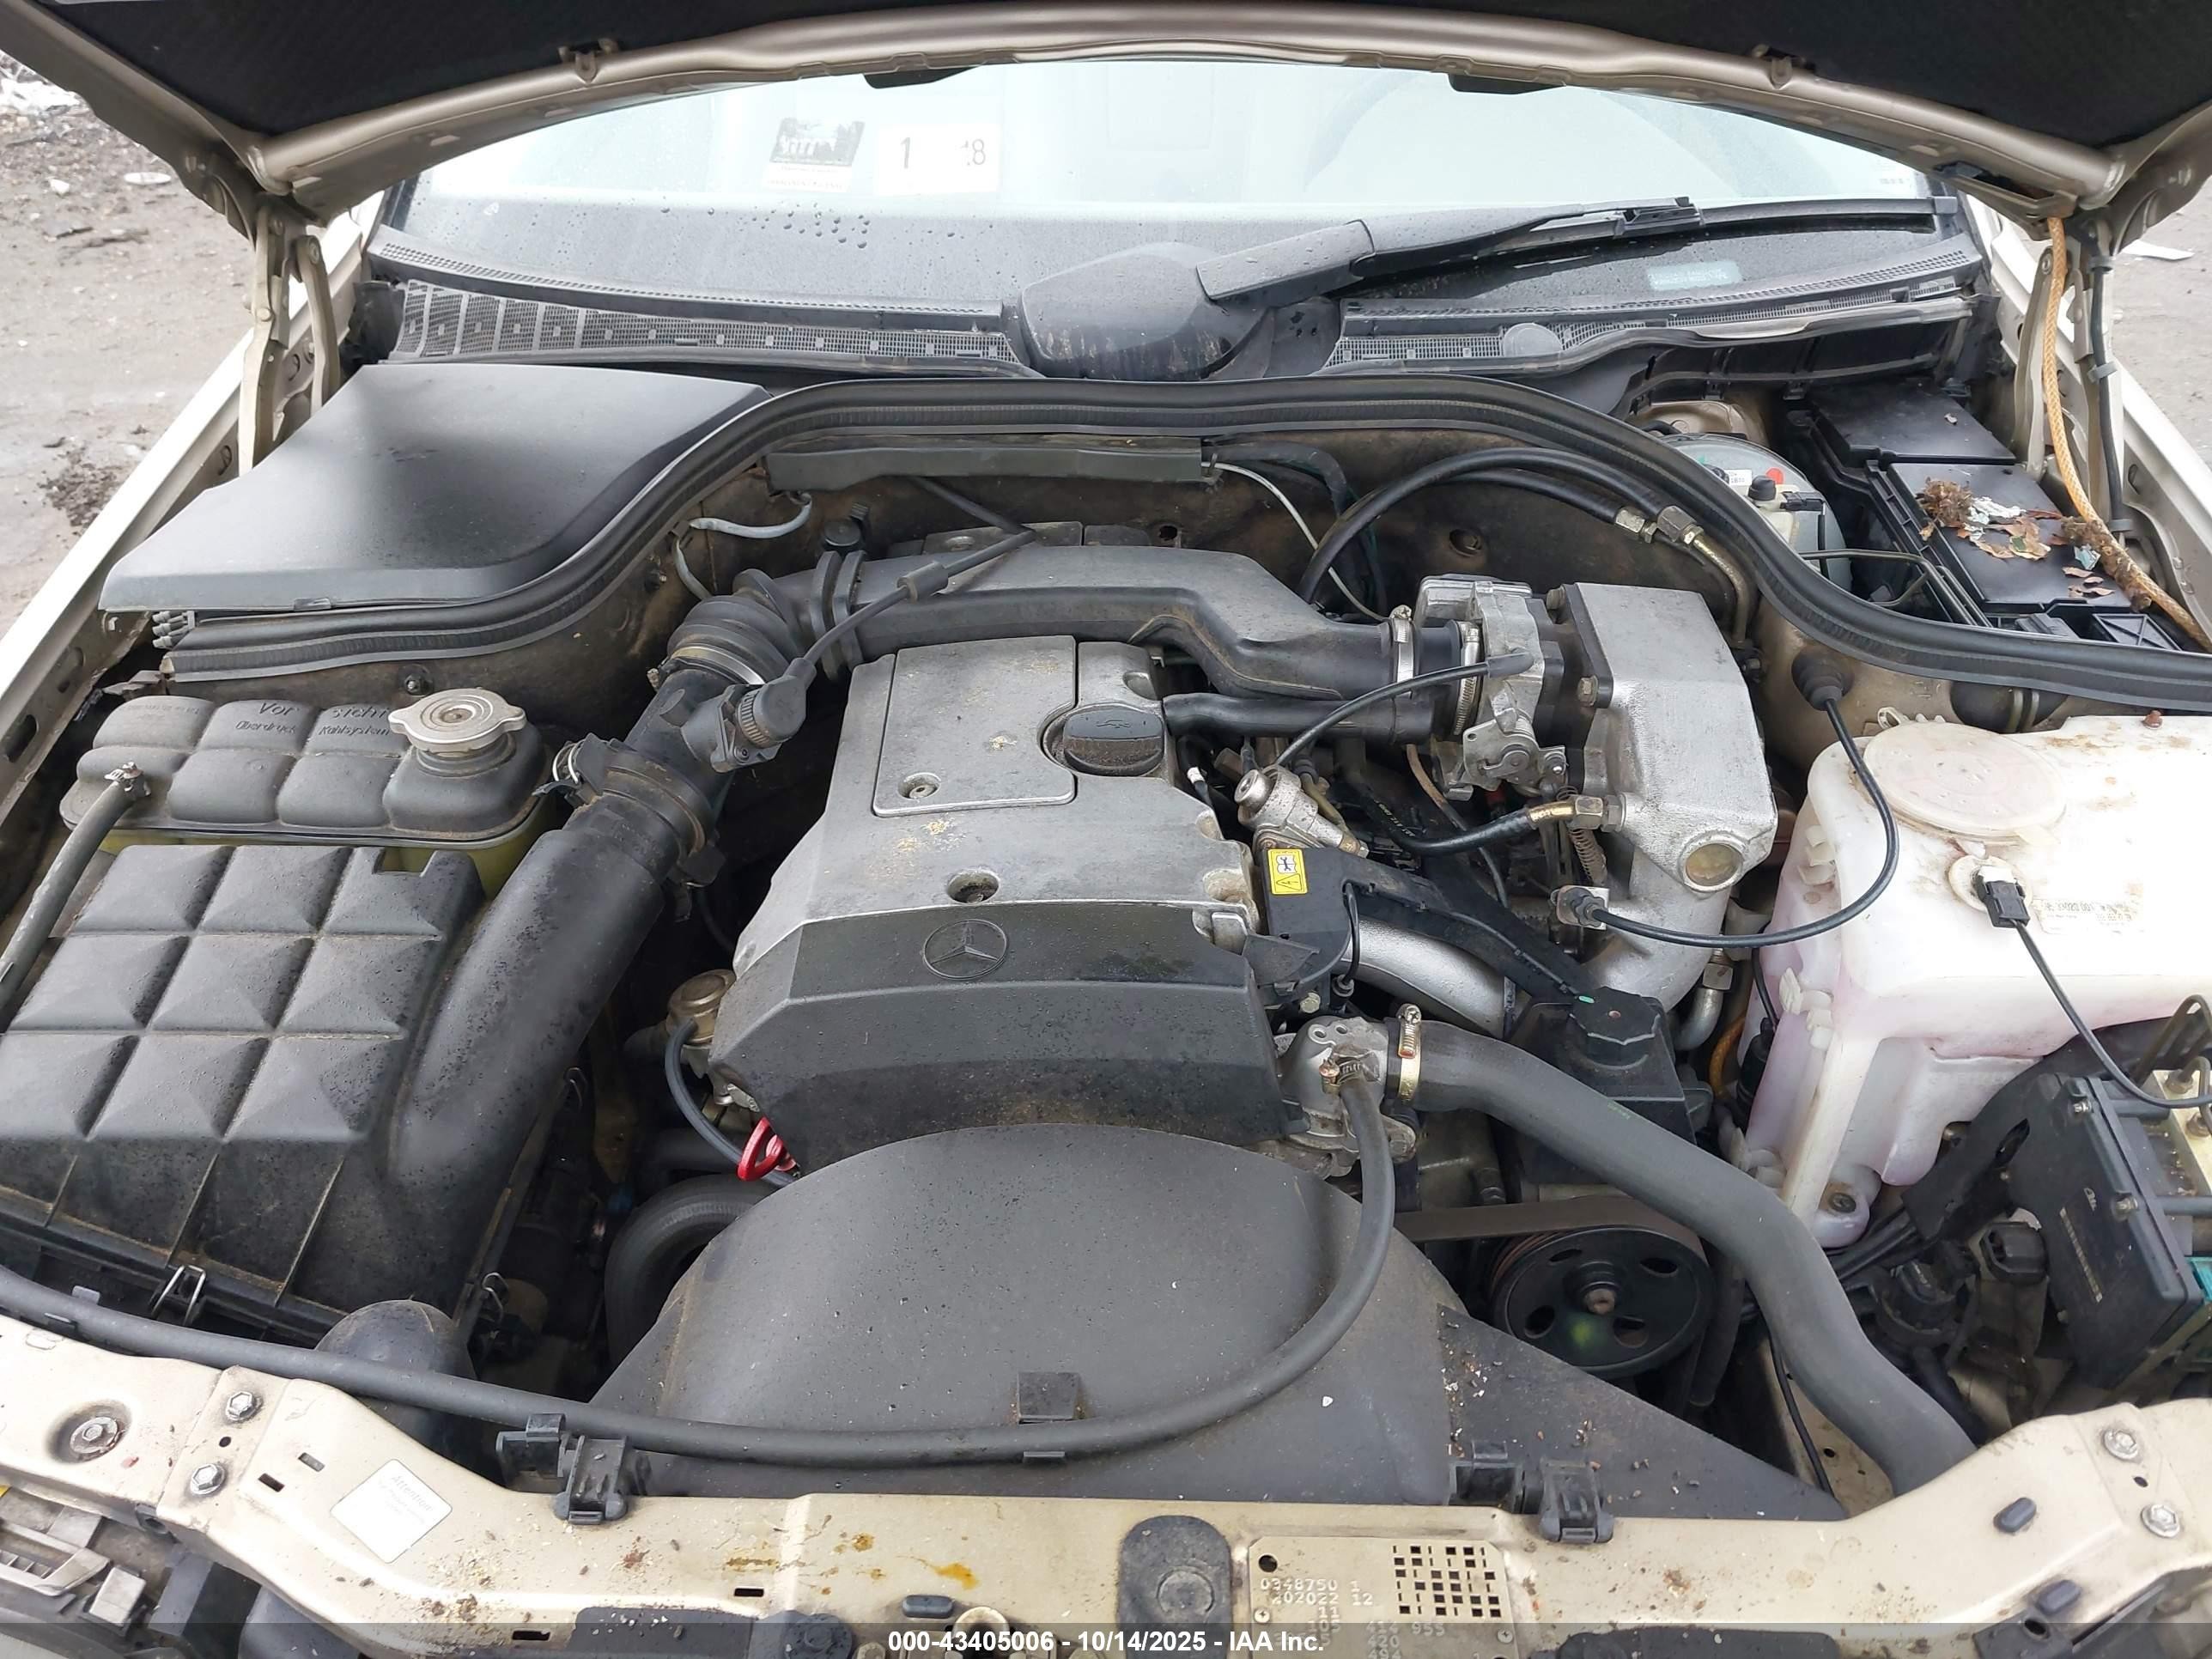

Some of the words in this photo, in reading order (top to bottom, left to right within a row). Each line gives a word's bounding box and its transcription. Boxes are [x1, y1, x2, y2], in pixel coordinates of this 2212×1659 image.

[259, 702, 295, 715] Vor
[1352, 1592, 1373, 1606] 12
[1318, 1606, 1340, 1619] 11
